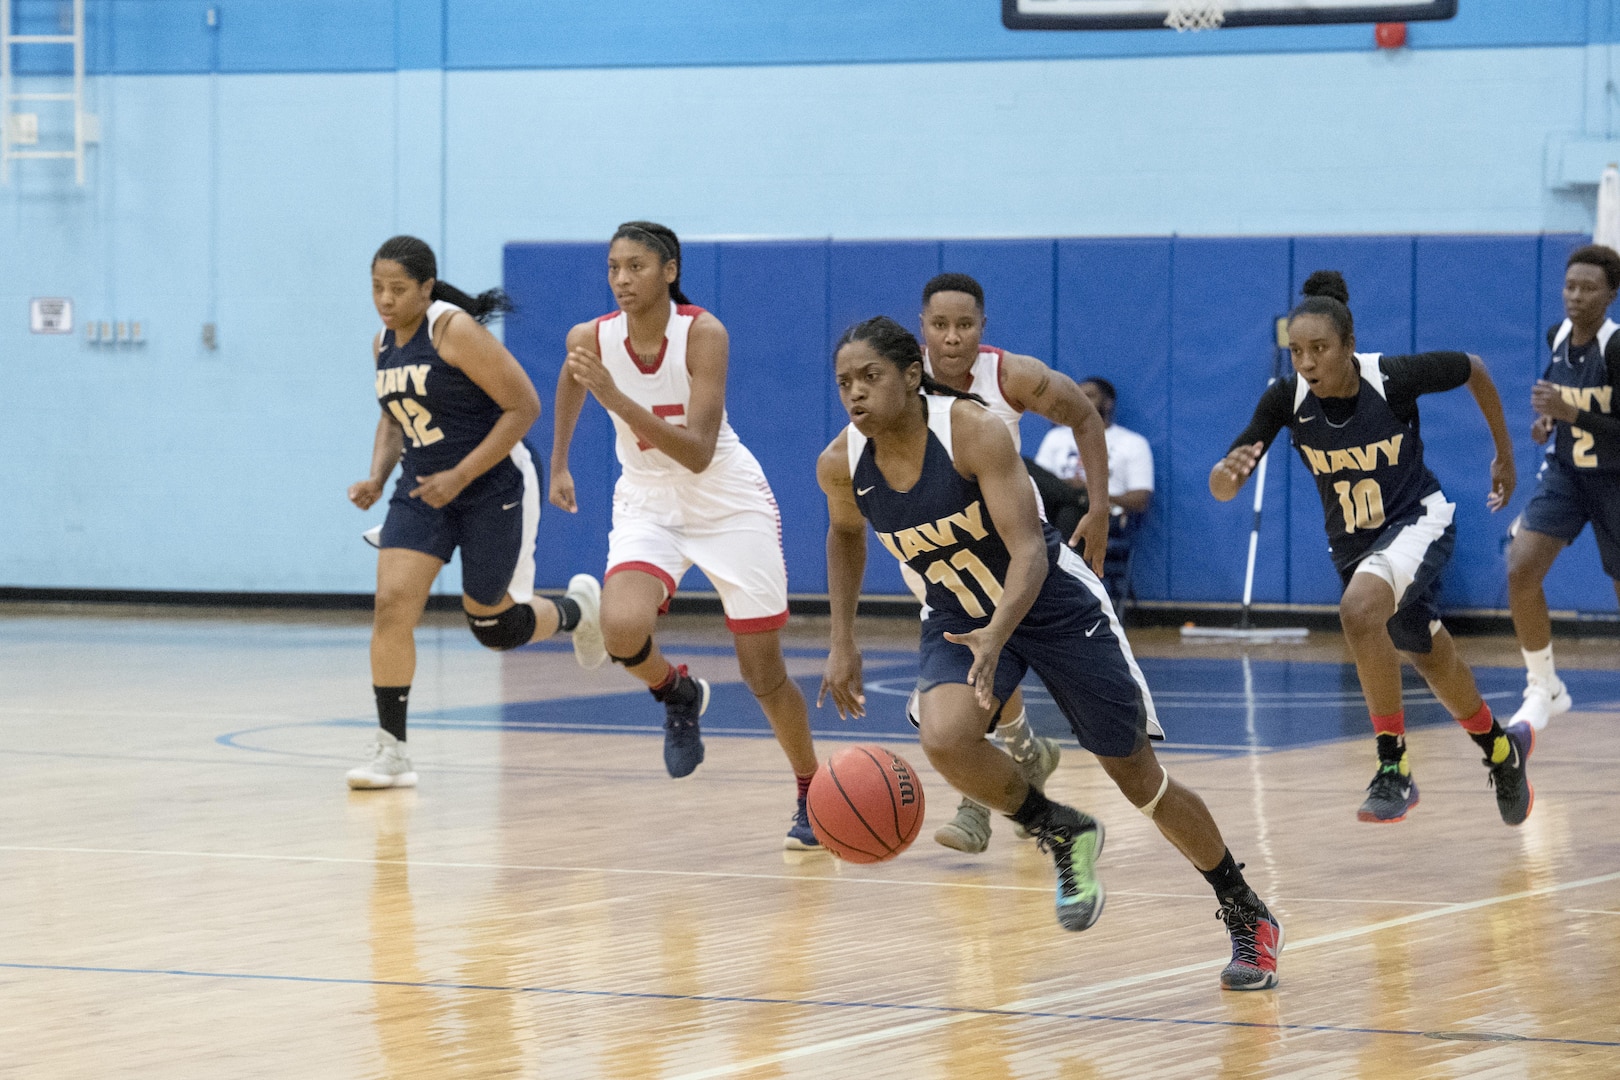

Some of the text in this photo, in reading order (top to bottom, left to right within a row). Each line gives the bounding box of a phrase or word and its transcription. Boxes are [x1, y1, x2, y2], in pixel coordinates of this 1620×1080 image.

[1552, 384, 1613, 413] AVY
[387, 398, 446, 448] 12
[1301, 433, 1404, 476] NAVY
[1570, 425, 1598, 468] 2
[1333, 478, 1386, 534] 10
[924, 548, 1004, 618] 11
